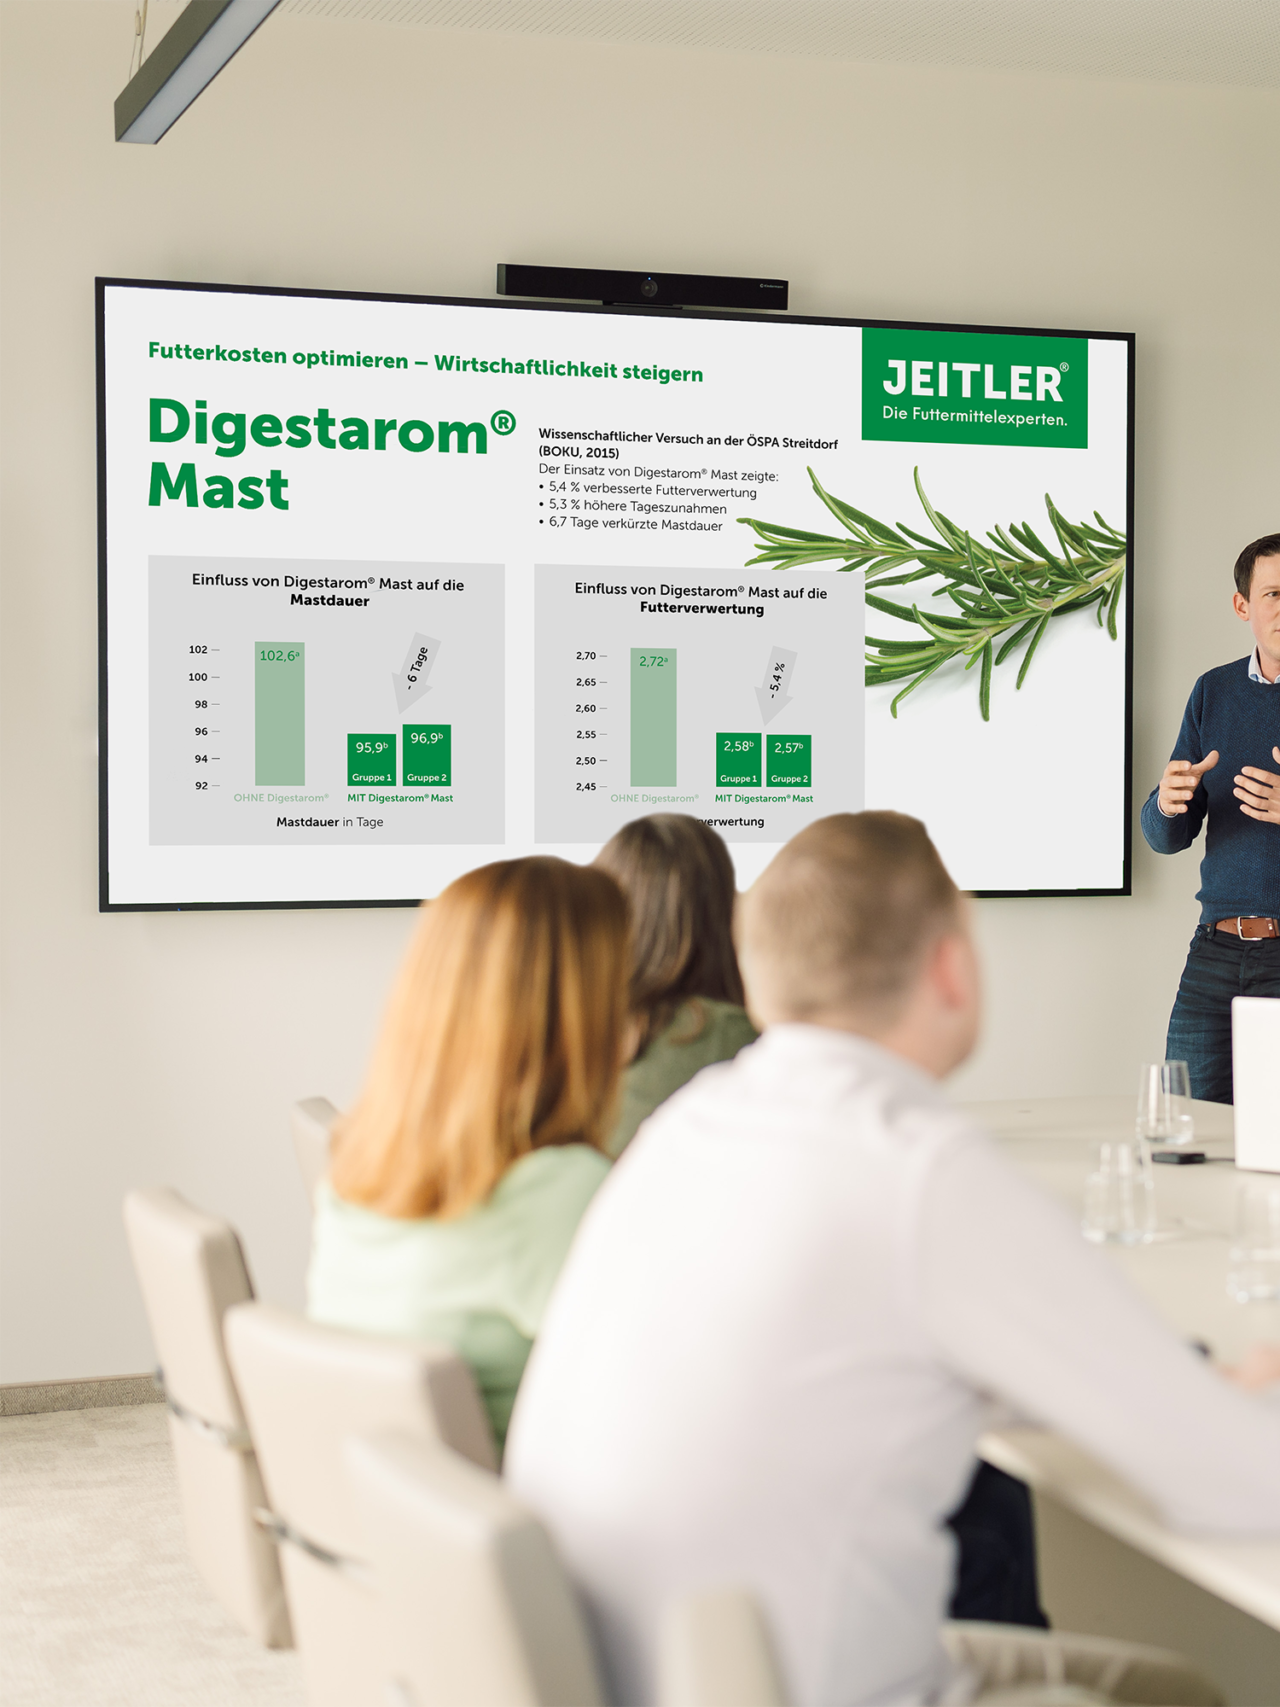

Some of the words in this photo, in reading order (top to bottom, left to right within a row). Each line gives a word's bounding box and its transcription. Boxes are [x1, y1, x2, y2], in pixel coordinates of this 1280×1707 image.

[148, 341, 287, 364] Futterkosten
[292, 349, 409, 370] optimieren
[433, 354, 618, 379] Wirtschaftlichkeit
[622, 364, 704, 385] steigern
[882, 405, 908, 420] Die
[912, 406, 1068, 428] Futtermittelexperten.
[538, 427, 654, 443] Wissenschaftlicher
[655, 432, 704, 445] Versuch
[706, 436, 722, 446] an
[723, 435, 745, 447] der
[746, 433, 780, 448] ÖSPA
[782, 437, 839, 450] Streitdorf
[538, 444, 583, 459] (BOKU,
[585, 446, 620, 460] 2015)
[538, 462, 561, 475] Der
[564, 463, 606, 477] Einsatz
[607, 467, 631, 477] von
[710, 469, 739, 481] Mast
[741, 470, 779, 485] zeigte:
[148, 462, 289, 510] Mast
[549, 480, 567, 493] 5,4
[570, 481, 581, 493] %
[583, 482, 653, 495] verbesserte
[655, 484, 757, 501] Futterverwertung
[549, 497, 568, 511] 5,3
[570, 498, 581, 511] %
[583, 499, 628, 512] höhere
[629, 500, 727, 515] Tageszunahmen
[548, 515, 568, 528] 6,7
[569, 516, 599, 531] Tage
[601, 517, 658, 530] verkürzte
[661, 518, 724, 532] Mastdauer
[192, 573, 249, 587] Einfluss
[251, 577, 280, 588] von
[378, 577, 414, 591] Mast
[416, 578, 440, 591] auf
[442, 579, 465, 592] die
[575, 581, 628, 595] Einfluss
[630, 586, 657, 596] von
[748, 585, 780, 599] Mast
[782, 587, 805, 599] auf
[807, 587, 828, 600] die
[290, 593, 371, 607] Mastdauer
[640, 600, 765, 618] Futterverwertung
[189, 644, 208, 655] 102
[409, 646, 429, 672] Tage
[576, 651, 597, 661] 2,70
[774, 662, 786, 673] %
[188, 672, 208, 682] 100
[407, 674, 418, 683] 6
[576, 677, 597, 688] 2,65
[769, 674, 782, 692] 5,4
[194, 699, 208, 709] 98
[575, 703, 597, 714] 2,60
[194, 726, 209, 736] 96
[576, 729, 597, 740] 2,55
[194, 754, 209, 764] 94
[575, 756, 597, 766] 2,50
[351, 773, 386, 783] Gruppe
[386, 773, 392, 782] 1
[406, 773, 440, 784] Gruppe
[441, 773, 447, 782] 2
[719, 774, 751, 784] Gruppe
[752, 774, 758, 783] 1
[770, 774, 803, 785] Gruppe
[802, 774, 809, 783] 2
[194, 781, 209, 791] 92
[575, 782, 597, 792] 2,45
[233, 793, 265, 803] OHNE
[347, 793, 367, 802] MIT
[430, 793, 454, 803] Mast
[610, 793, 640, 803] OHNE
[714, 793, 733, 803] MIT
[792, 794, 814, 803] Mast
[276, 816, 340, 827] Mastdauer
[342, 816, 354, 827] in
[356, 816, 384, 830] Tage
